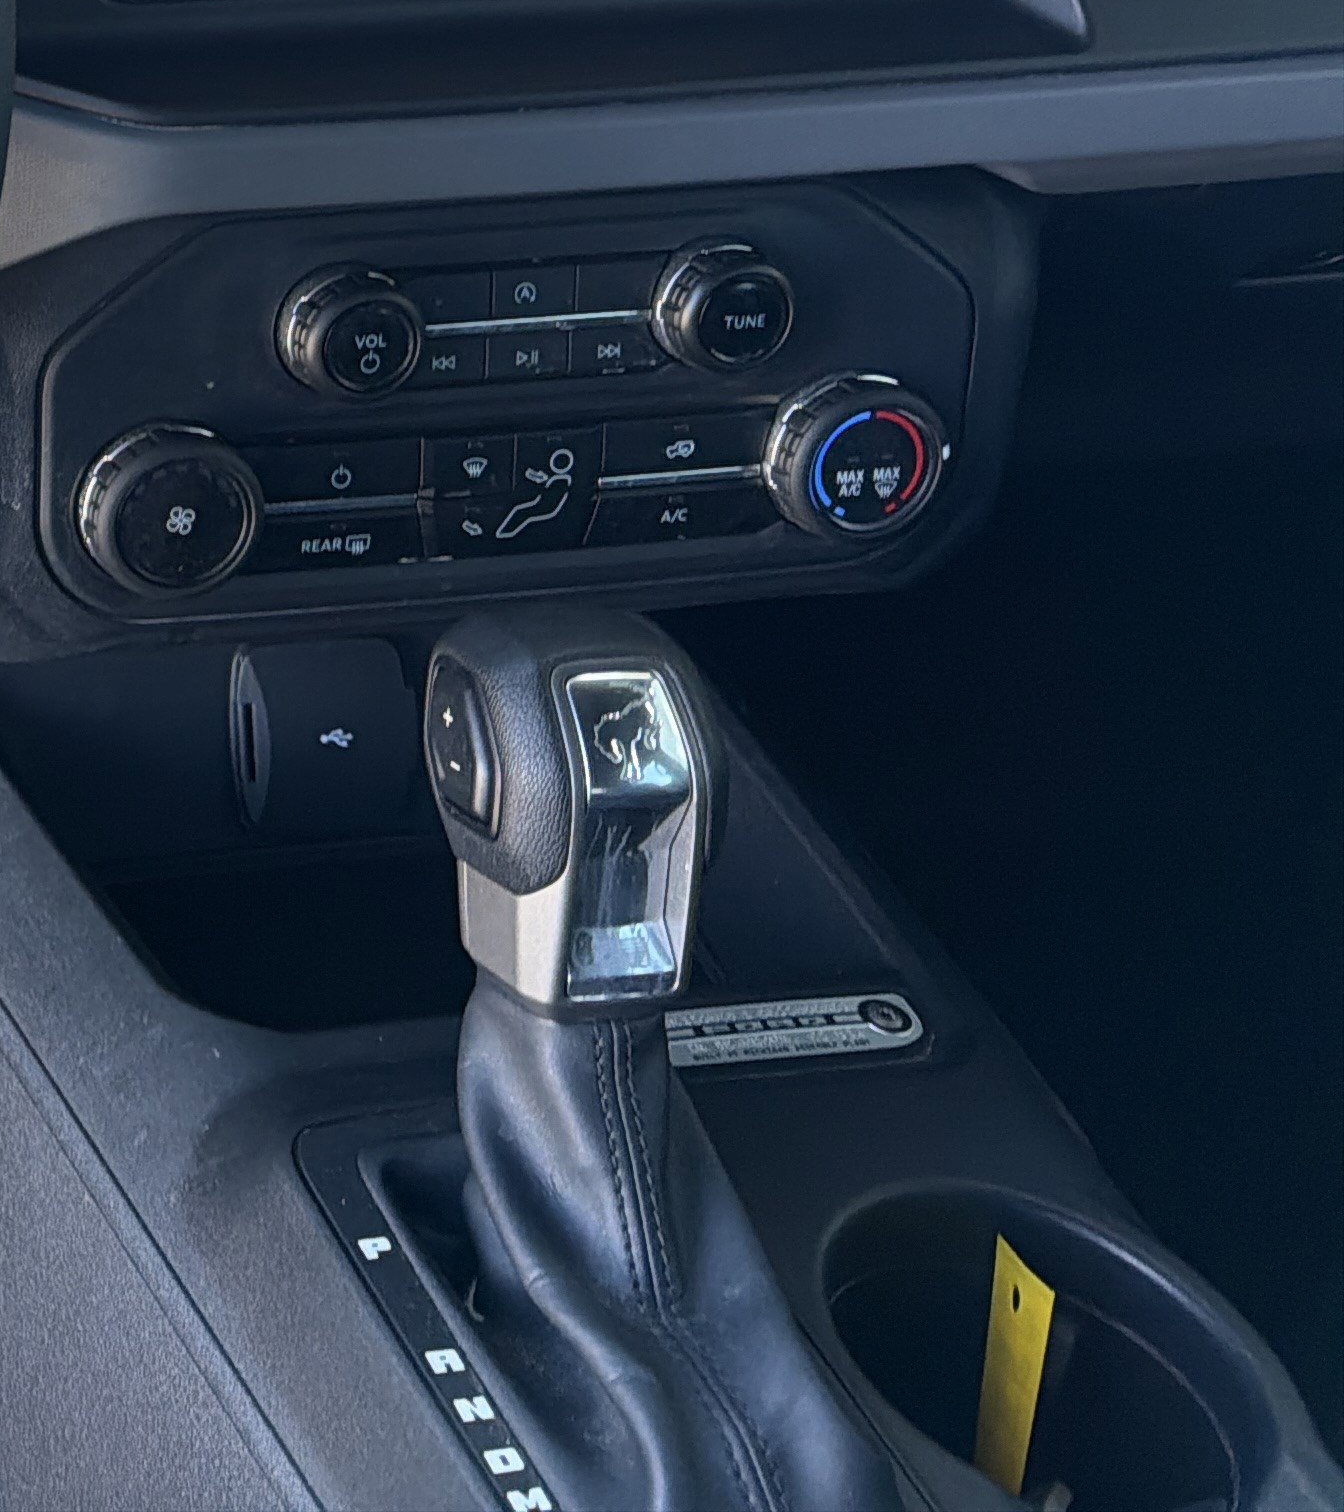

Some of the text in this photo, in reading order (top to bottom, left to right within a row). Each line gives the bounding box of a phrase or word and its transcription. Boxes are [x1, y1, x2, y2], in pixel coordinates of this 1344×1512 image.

[724, 313, 767, 330] TUNE
[354, 332, 387, 350] VOL
[836, 469, 865, 485] MAX
[873, 466, 901, 482] MAX
[838, 483, 861, 498] A/C
[660, 508, 688, 523] A/C
[301, 537, 342, 554] REAR
[358, 1236, 391, 1260] P
[453, 1396, 494, 1422] N
[484, 1447, 525, 1474] D
[507, 1487, 552, 1512] M
